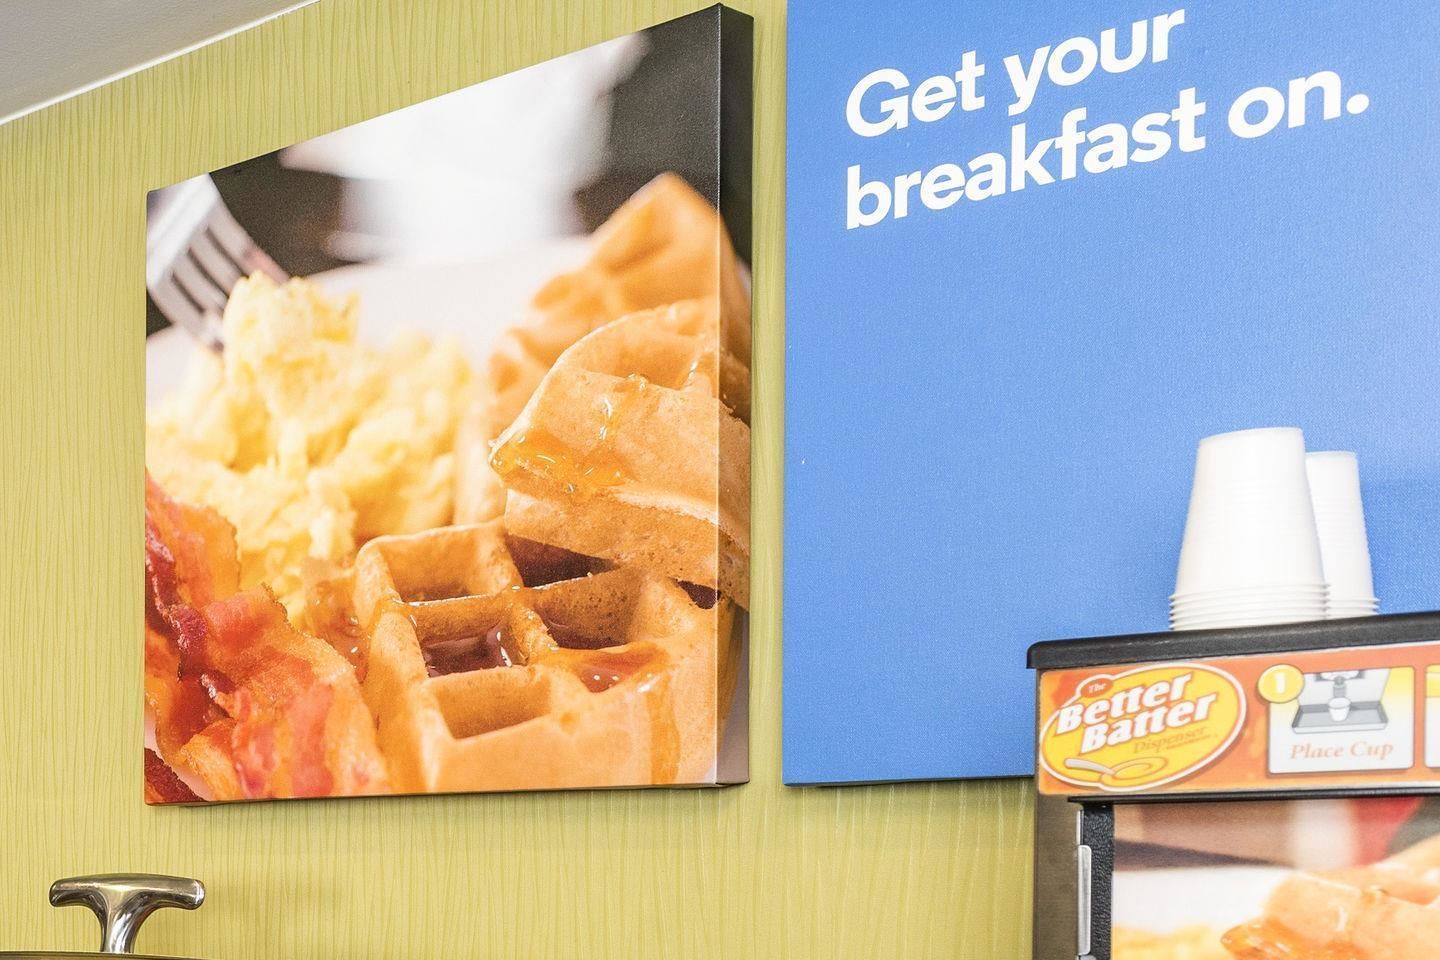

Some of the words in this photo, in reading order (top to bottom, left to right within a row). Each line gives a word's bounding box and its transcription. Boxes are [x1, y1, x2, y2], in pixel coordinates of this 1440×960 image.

[846, 50, 985, 137] Get
[1003, 8, 1185, 115] your
[846, 87, 1207, 230] breakfast
[1227, 68, 1370, 139] on.
[1055, 672, 1193, 736] Better
[1088, 682, 1107, 694] The
[1275, 673, 1287, 694] 1
[1080, 692, 1217, 755] Batter
[1134, 725, 1206, 753] Dispenser
[1290, 741, 1345, 760] Place
[1349, 740, 1394, 760] Cup
